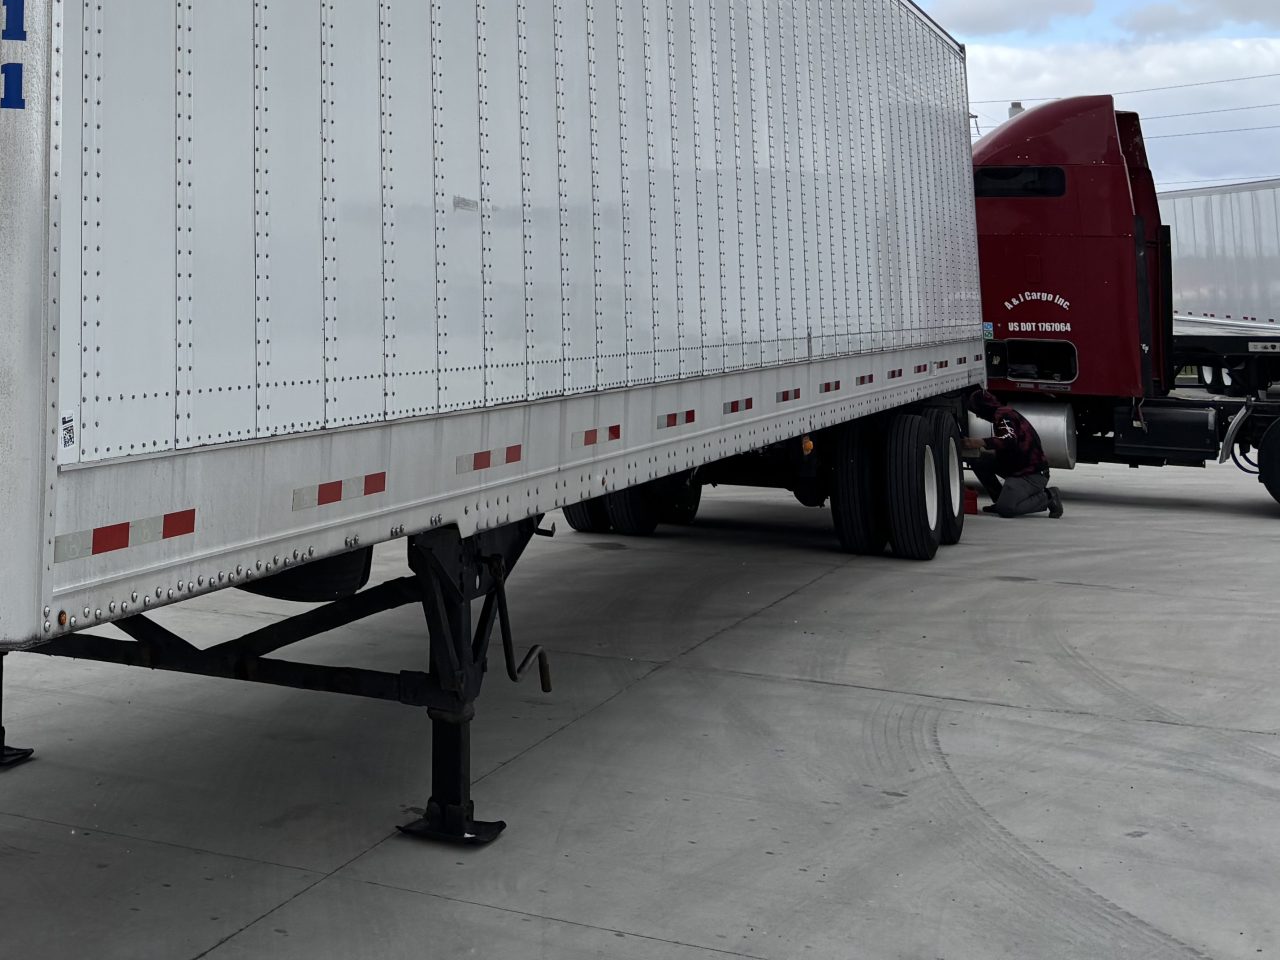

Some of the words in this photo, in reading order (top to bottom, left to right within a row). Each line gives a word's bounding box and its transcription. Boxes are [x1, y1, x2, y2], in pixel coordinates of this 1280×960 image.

[1004, 302, 1013, 310] A
[1024, 292, 1054, 301] Cargo
[1054, 294, 1070, 310] Inc.
[1008, 322, 1020, 332] US
[1020, 322, 1037, 332] DOT
[1038, 322, 1071, 331] 1767064
